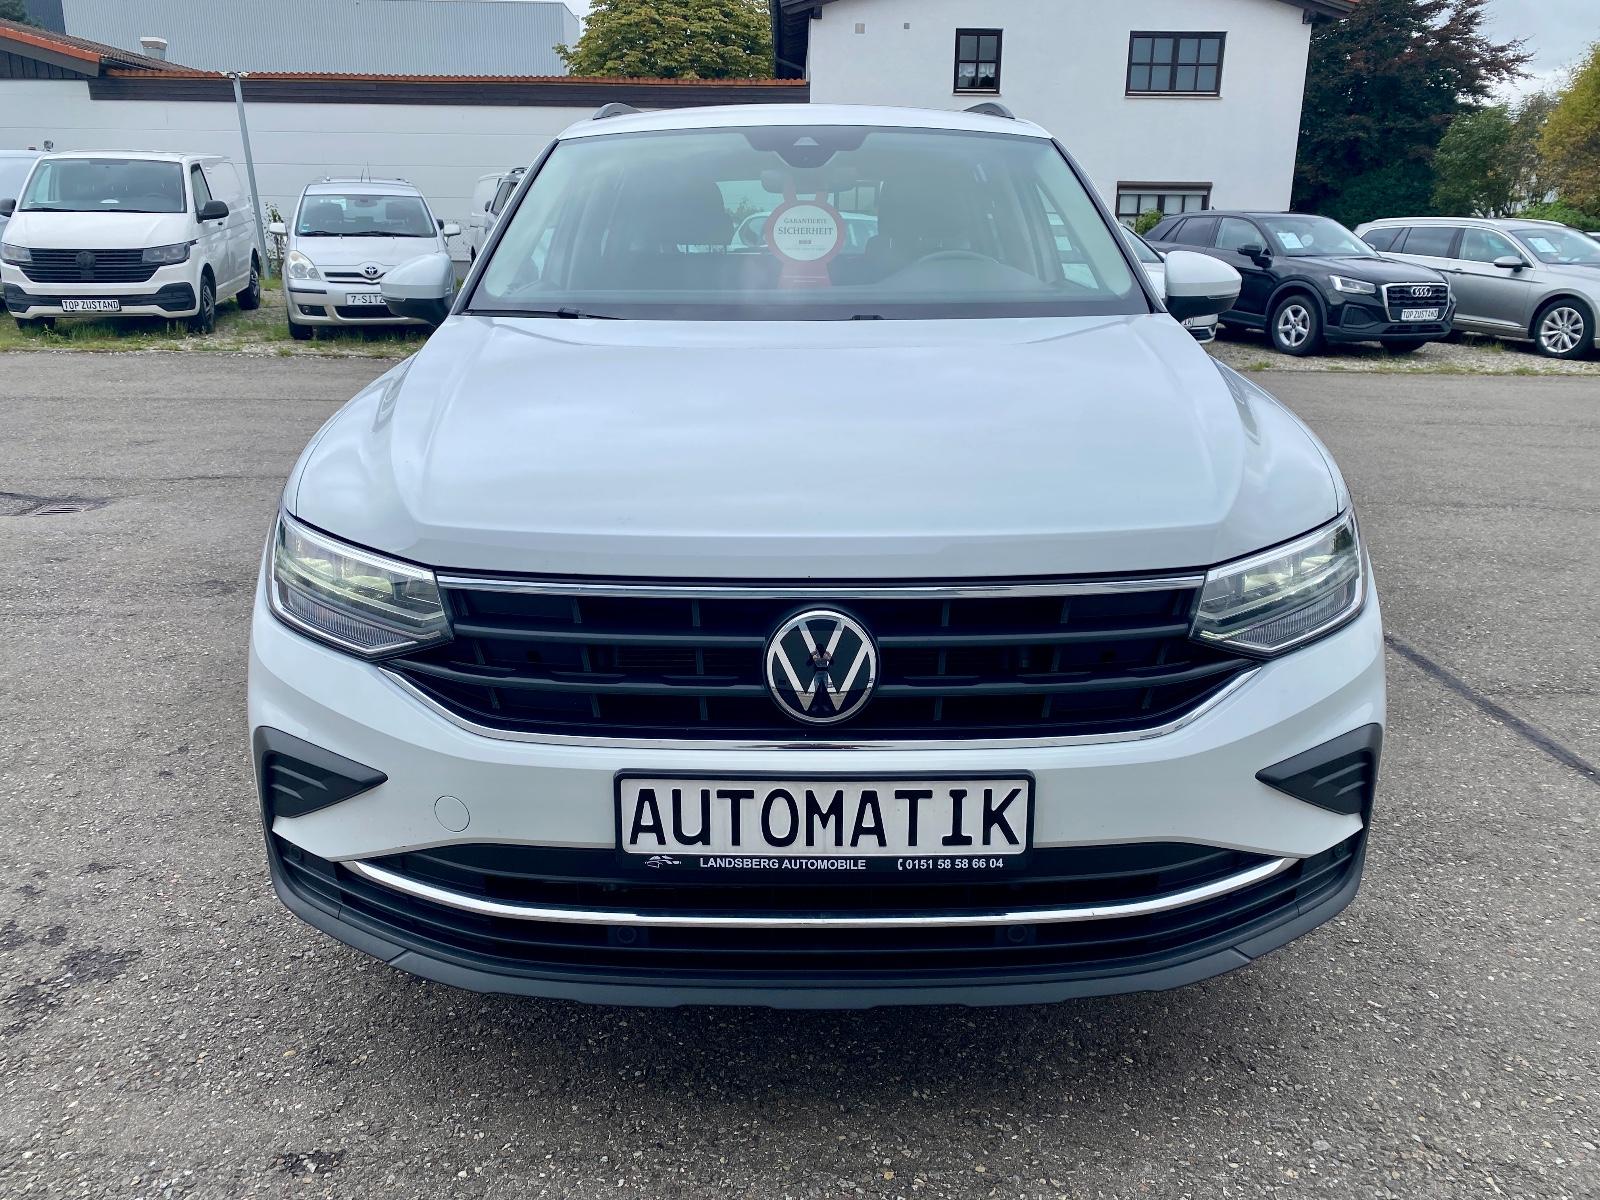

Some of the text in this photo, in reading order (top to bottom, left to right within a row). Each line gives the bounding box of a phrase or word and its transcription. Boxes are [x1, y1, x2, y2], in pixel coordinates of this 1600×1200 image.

[778, 227, 833, 235] SICHERHEIT
[63, 301, 118, 310] TOP ZUSTAND
[1403, 310, 1413, 319] TOP
[629, 788, 1022, 847] AUTOMATIK
[700, 858, 867, 870] LANDSBERG AUTOMOBILE
[906, 859, 1004, 870] 0151 58 58 66 04
